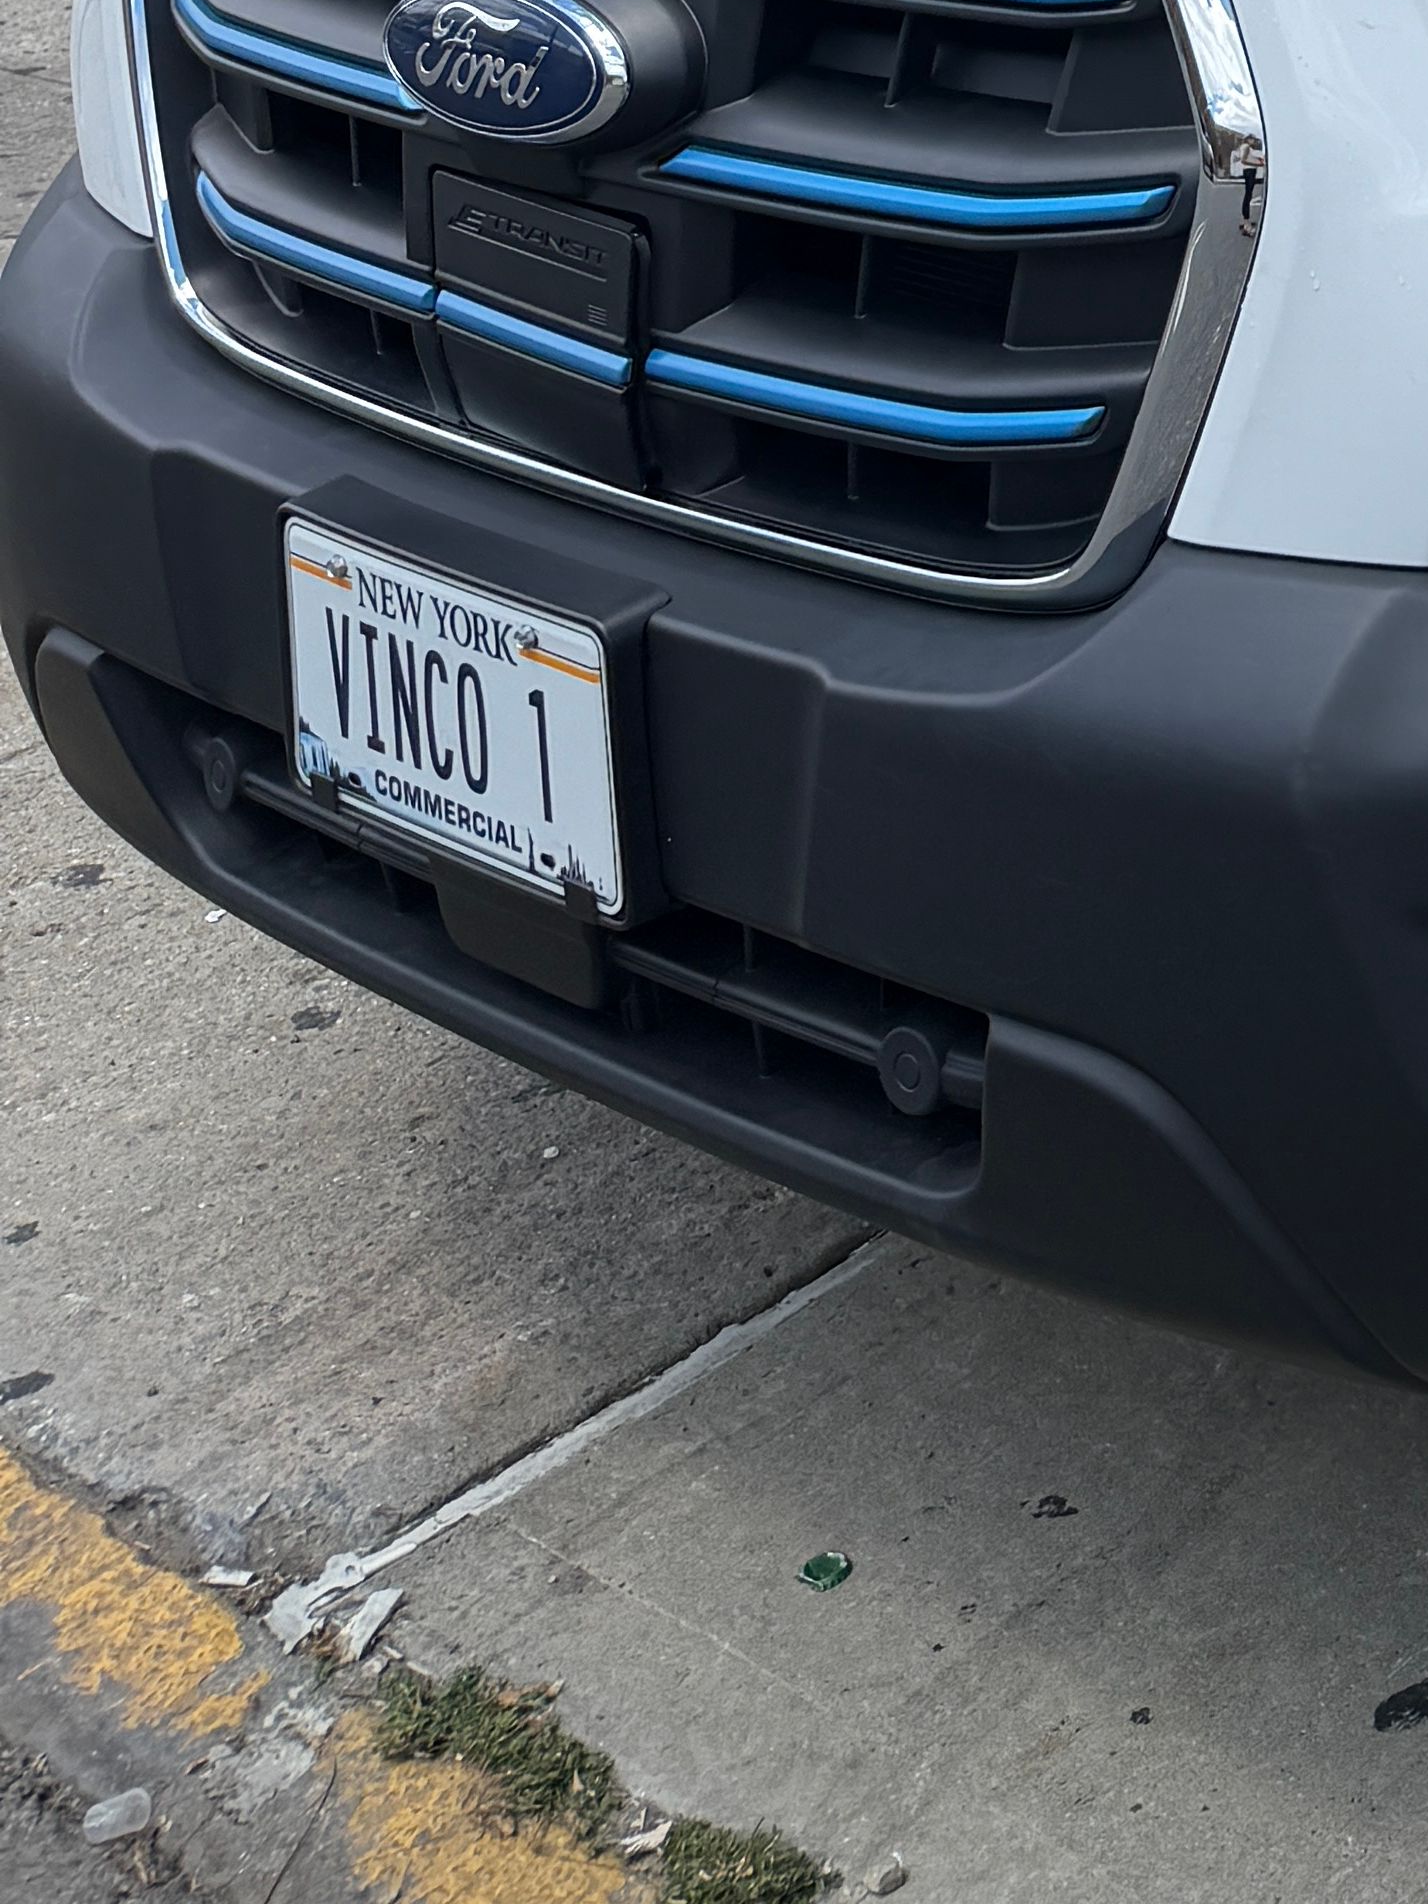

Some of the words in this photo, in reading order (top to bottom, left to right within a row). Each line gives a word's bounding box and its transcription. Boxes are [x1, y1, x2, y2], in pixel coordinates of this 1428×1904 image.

[415, 1, 550, 109] Ford
[355, 566, 424, 630] NEW
[430, 595, 518, 667] YORK
[326, 607, 489, 795] VINCO
[528, 689, 553, 824] 1
[375, 769, 523, 854] COMMERCIAL
